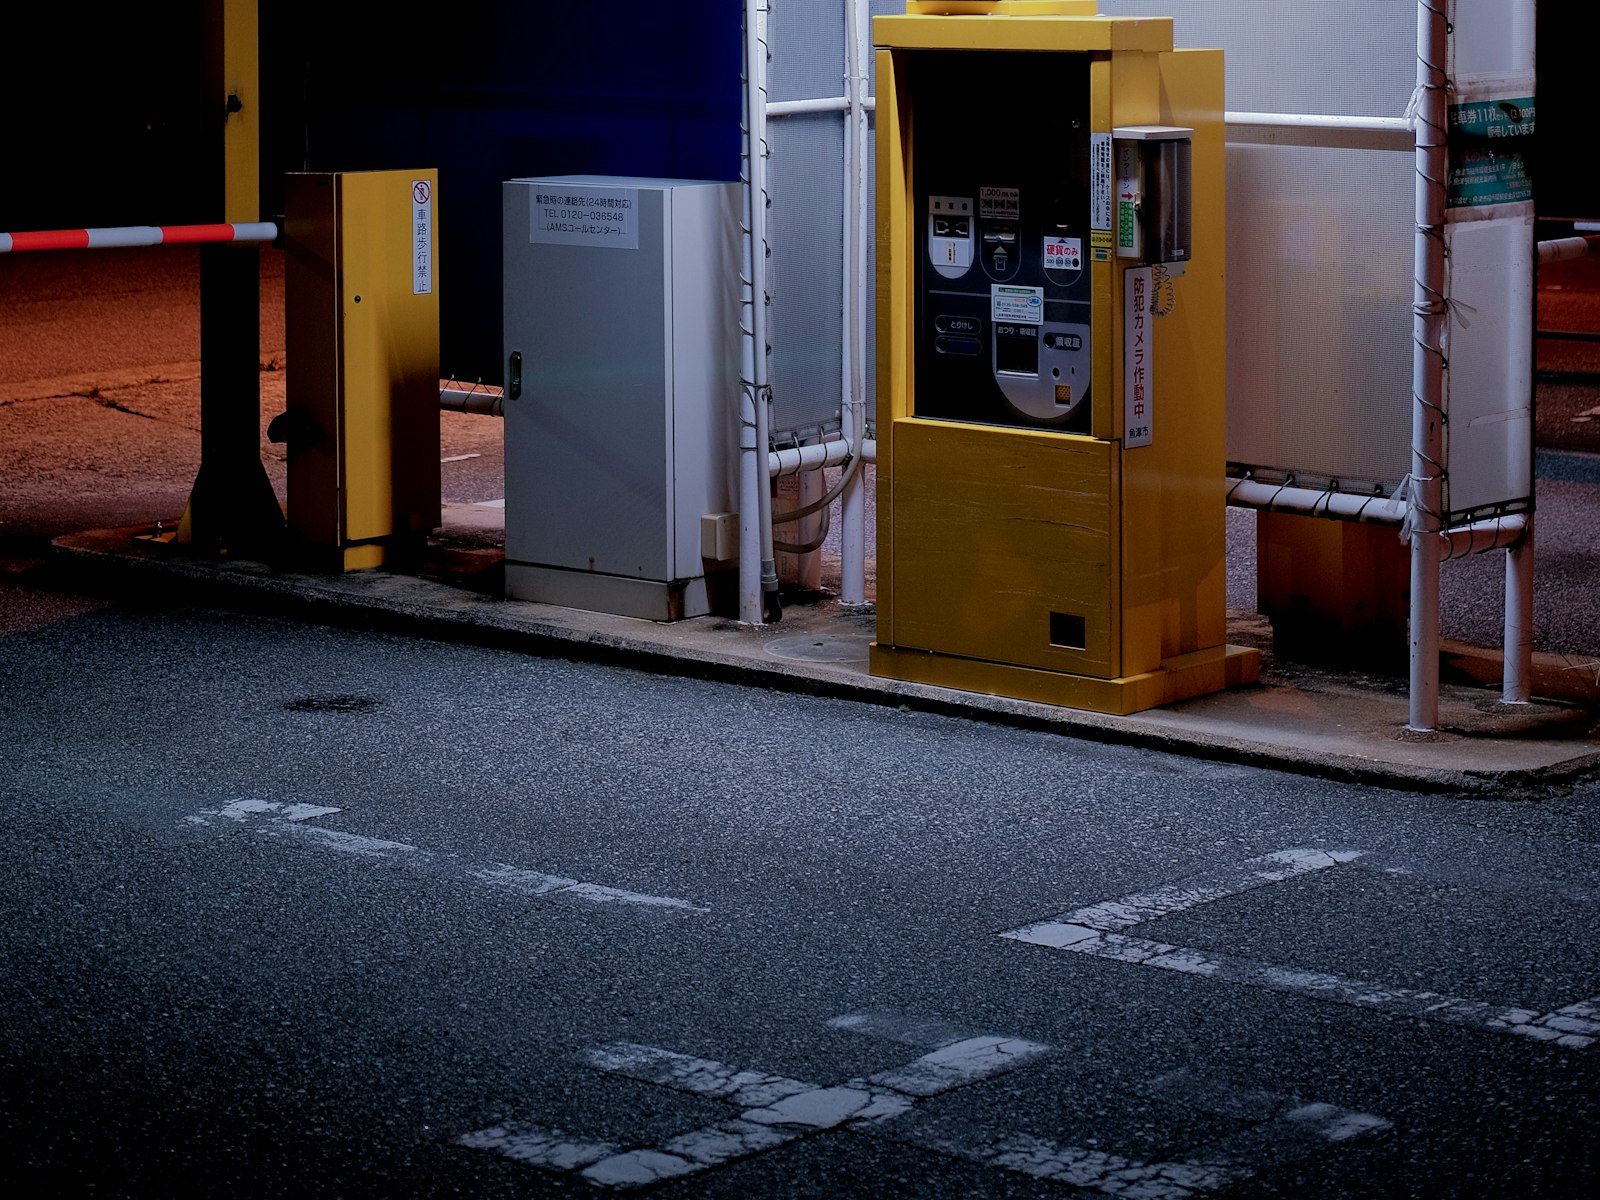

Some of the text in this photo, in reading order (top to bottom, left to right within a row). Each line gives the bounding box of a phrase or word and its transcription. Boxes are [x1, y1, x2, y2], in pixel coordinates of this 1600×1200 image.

[1487, 121, 1536, 139] 販売しています
[535, 194, 632, 209] 緊急時の連絡先(24時間対応)
[544, 208, 559, 218] TEL
[546, 222, 621, 235] (AMSコールセンター)
[416, 209, 428, 292] 車路歩行禁止
[1046, 244, 1079, 256] 硬貨のみ
[950, 320, 973, 330] とりけし
[1055, 336, 1081, 349] 領収証
[1133, 277, 1145, 419] 防犯カメラ作動中
[1129, 425, 1149, 439] 魚津市
